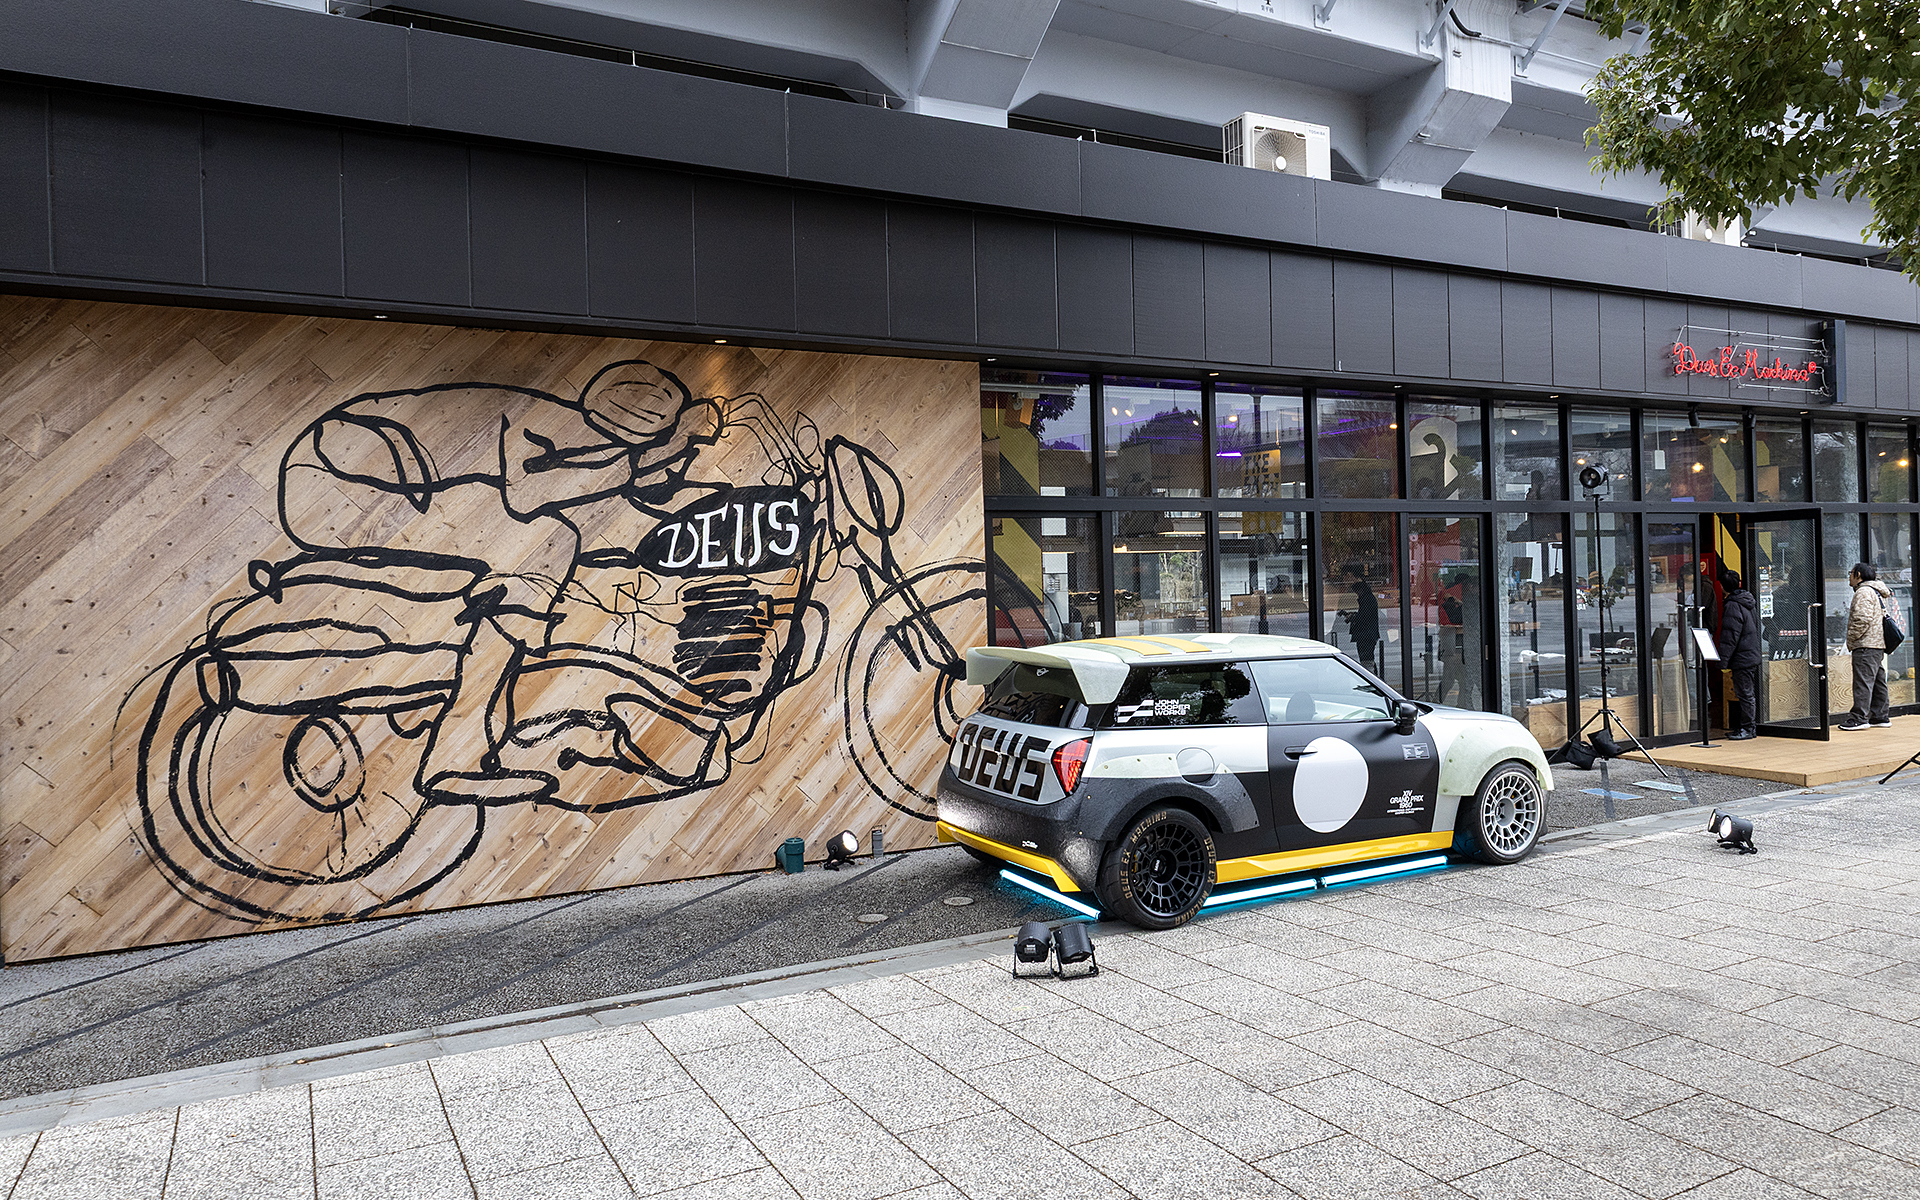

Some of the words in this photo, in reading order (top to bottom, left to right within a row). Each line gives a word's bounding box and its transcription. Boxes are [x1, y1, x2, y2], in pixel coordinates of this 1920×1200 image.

[1673, 342, 1718, 377] Deus
[657, 498, 800, 569] DEUS
[956, 723, 1053, 802] DEUS
[1389, 796, 1410, 804] GRAND
[1410, 794, 1424, 802] PRIX
[1130, 811, 1167, 843] MACHINA
[1121, 849, 1131, 864] EX
[1120, 870, 1133, 899] DEUS
[1175, 890, 1209, 925] MACHINA
